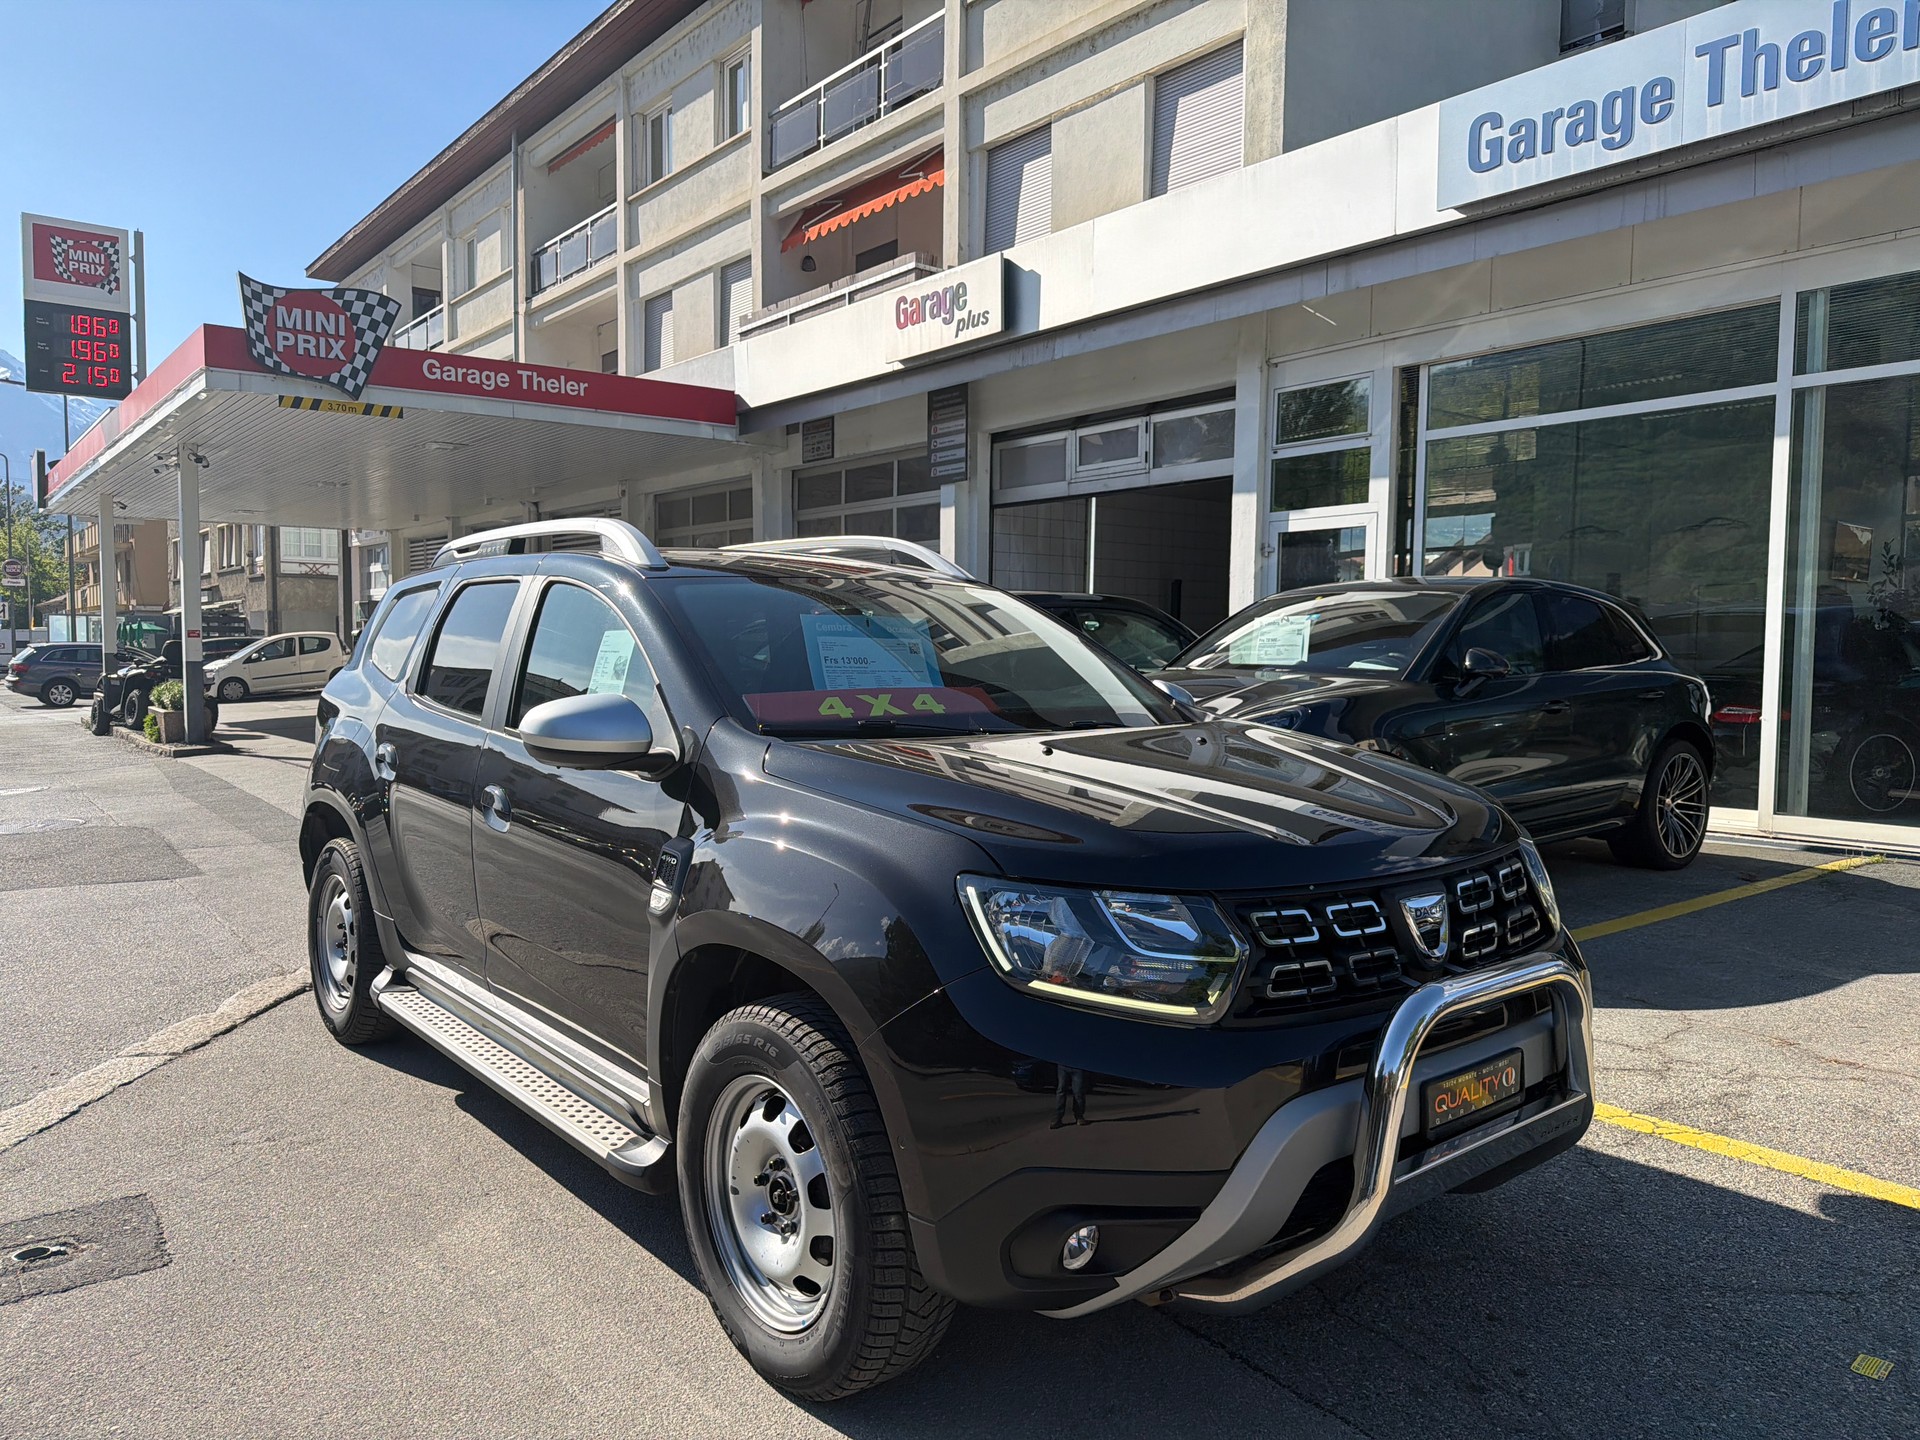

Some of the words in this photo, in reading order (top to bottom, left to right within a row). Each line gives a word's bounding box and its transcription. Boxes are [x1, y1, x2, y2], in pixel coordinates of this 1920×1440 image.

[1468, 76, 1675, 174] Garage
[68, 249, 105, 265] MINI
[68, 261, 106, 277] PRIX
[895, 282, 968, 330] Garage
[276, 305, 346, 337] MINI
[955, 310, 990, 339] plus
[276, 331, 347, 361] PRIX
[422, 358, 510, 391] Garage
[516, 369, 589, 397] Theler
[823, 656, 839, 665] Frs
[661, 854, 677, 865] 4WD
